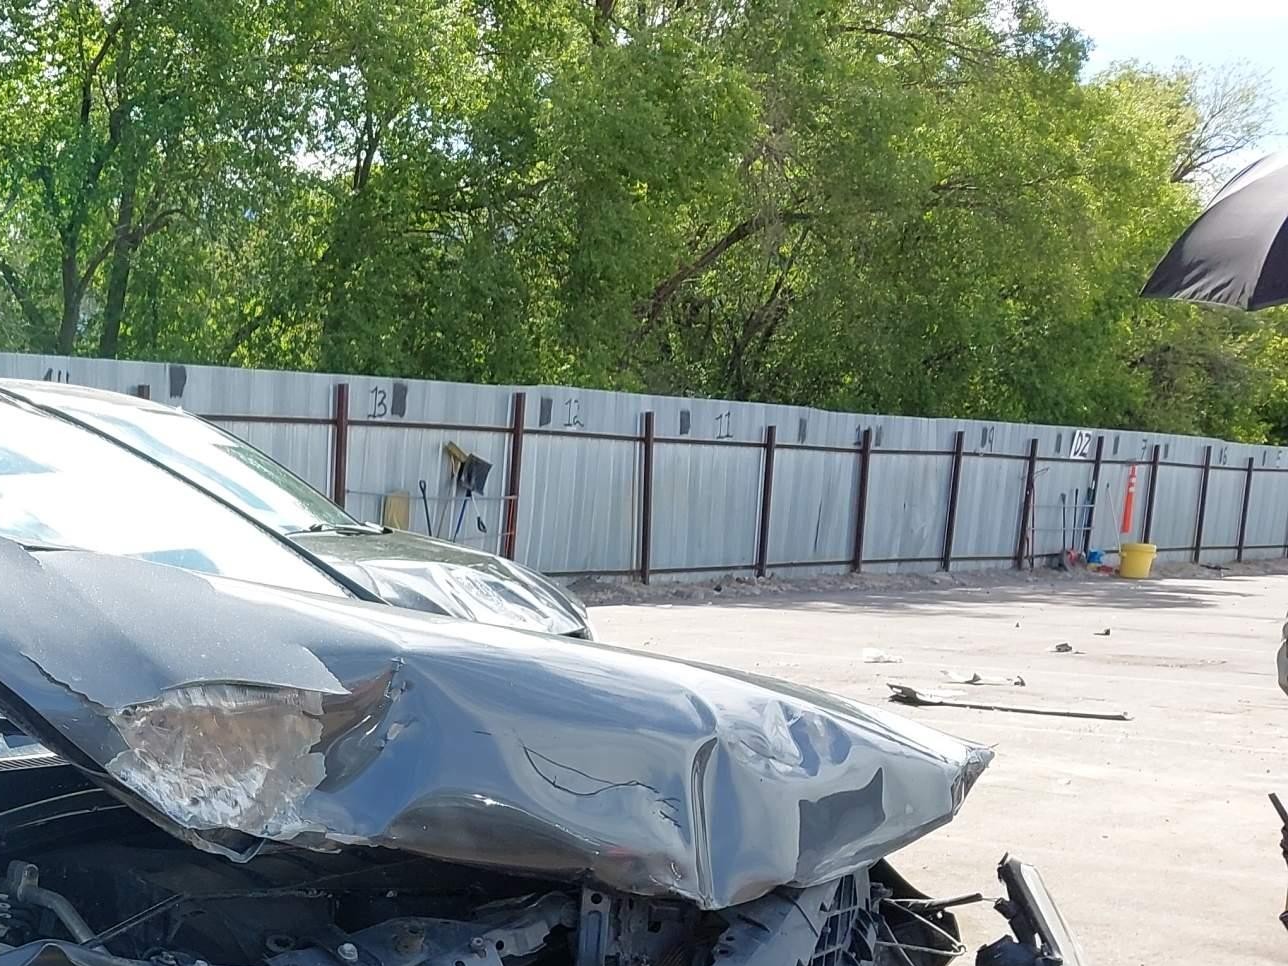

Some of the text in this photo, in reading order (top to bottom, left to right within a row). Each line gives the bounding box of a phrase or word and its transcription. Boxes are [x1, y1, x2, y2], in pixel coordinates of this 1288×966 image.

[367, 386, 387, 418] 13
[563, 398, 584, 427] 12
[715, 411, 733, 439] 11
